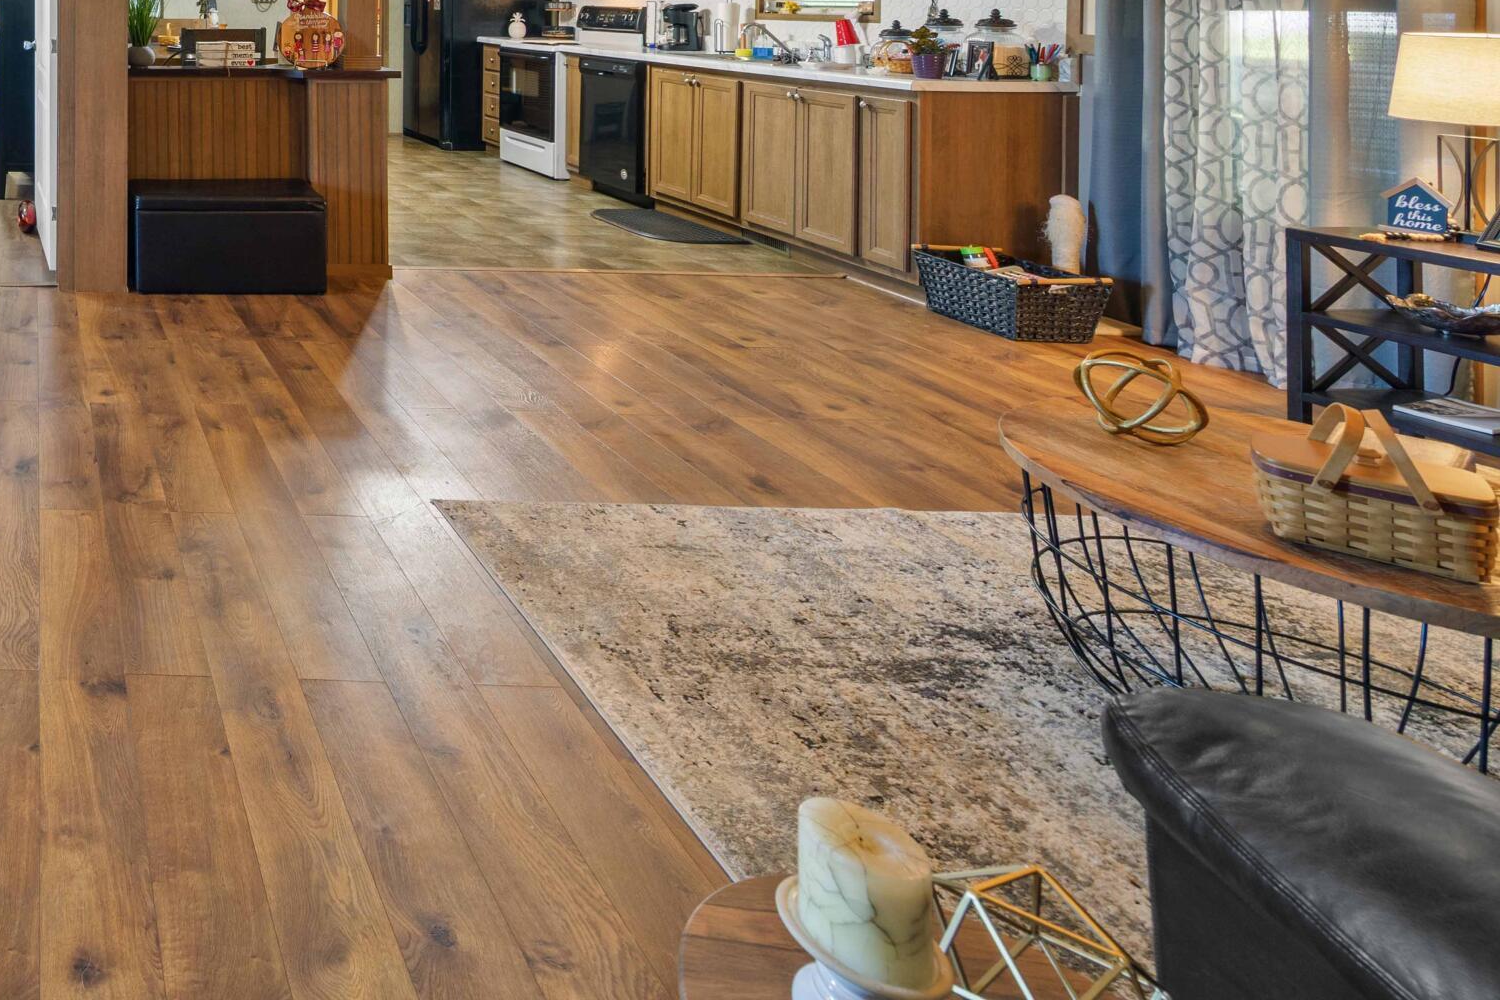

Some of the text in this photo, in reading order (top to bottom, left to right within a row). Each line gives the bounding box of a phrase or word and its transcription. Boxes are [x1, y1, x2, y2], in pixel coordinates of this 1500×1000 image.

[1395, 194, 1442, 212] bless
[1393, 213, 1444, 231] home
[1407, 210, 1433, 222] this
